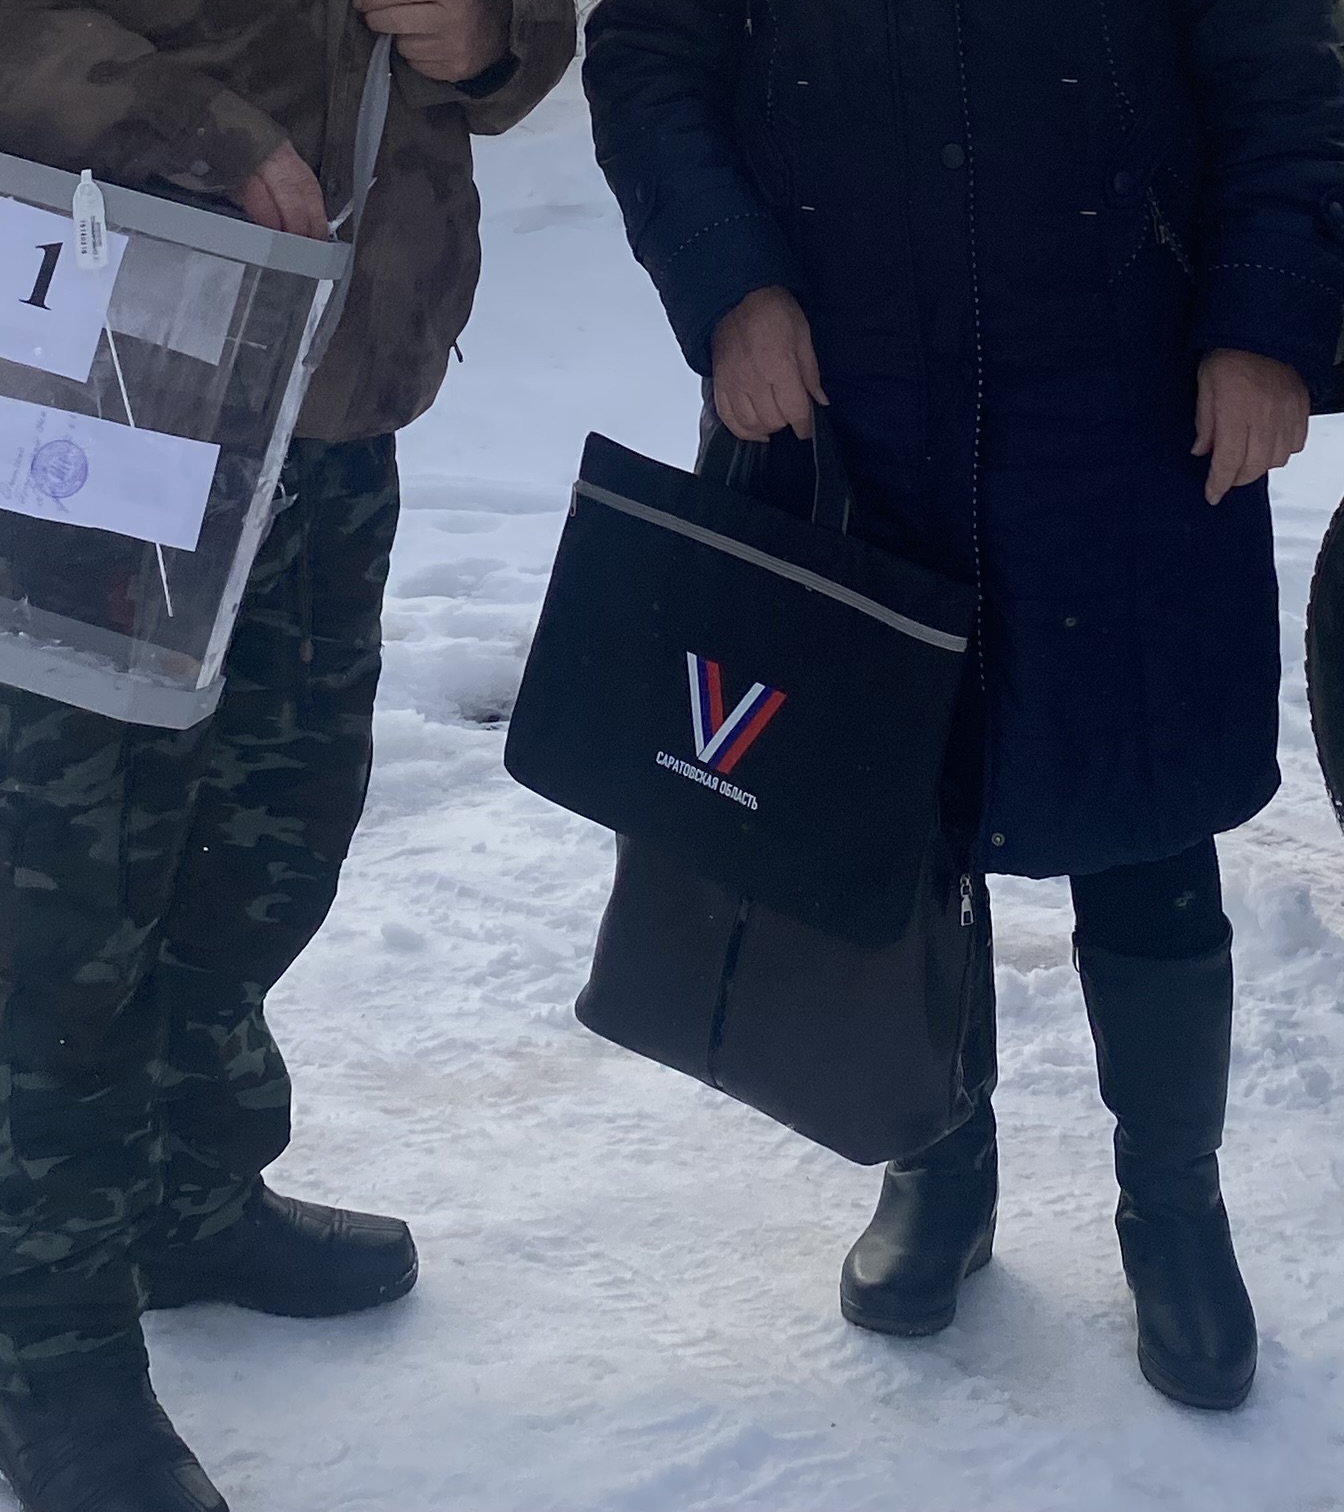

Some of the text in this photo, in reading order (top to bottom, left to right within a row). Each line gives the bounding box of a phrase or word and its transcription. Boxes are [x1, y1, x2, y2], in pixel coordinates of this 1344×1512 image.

[18, 241, 63, 311] 1
[656, 750, 758, 811] САРАТОВСКАЯ ОБЛАСТЬ
